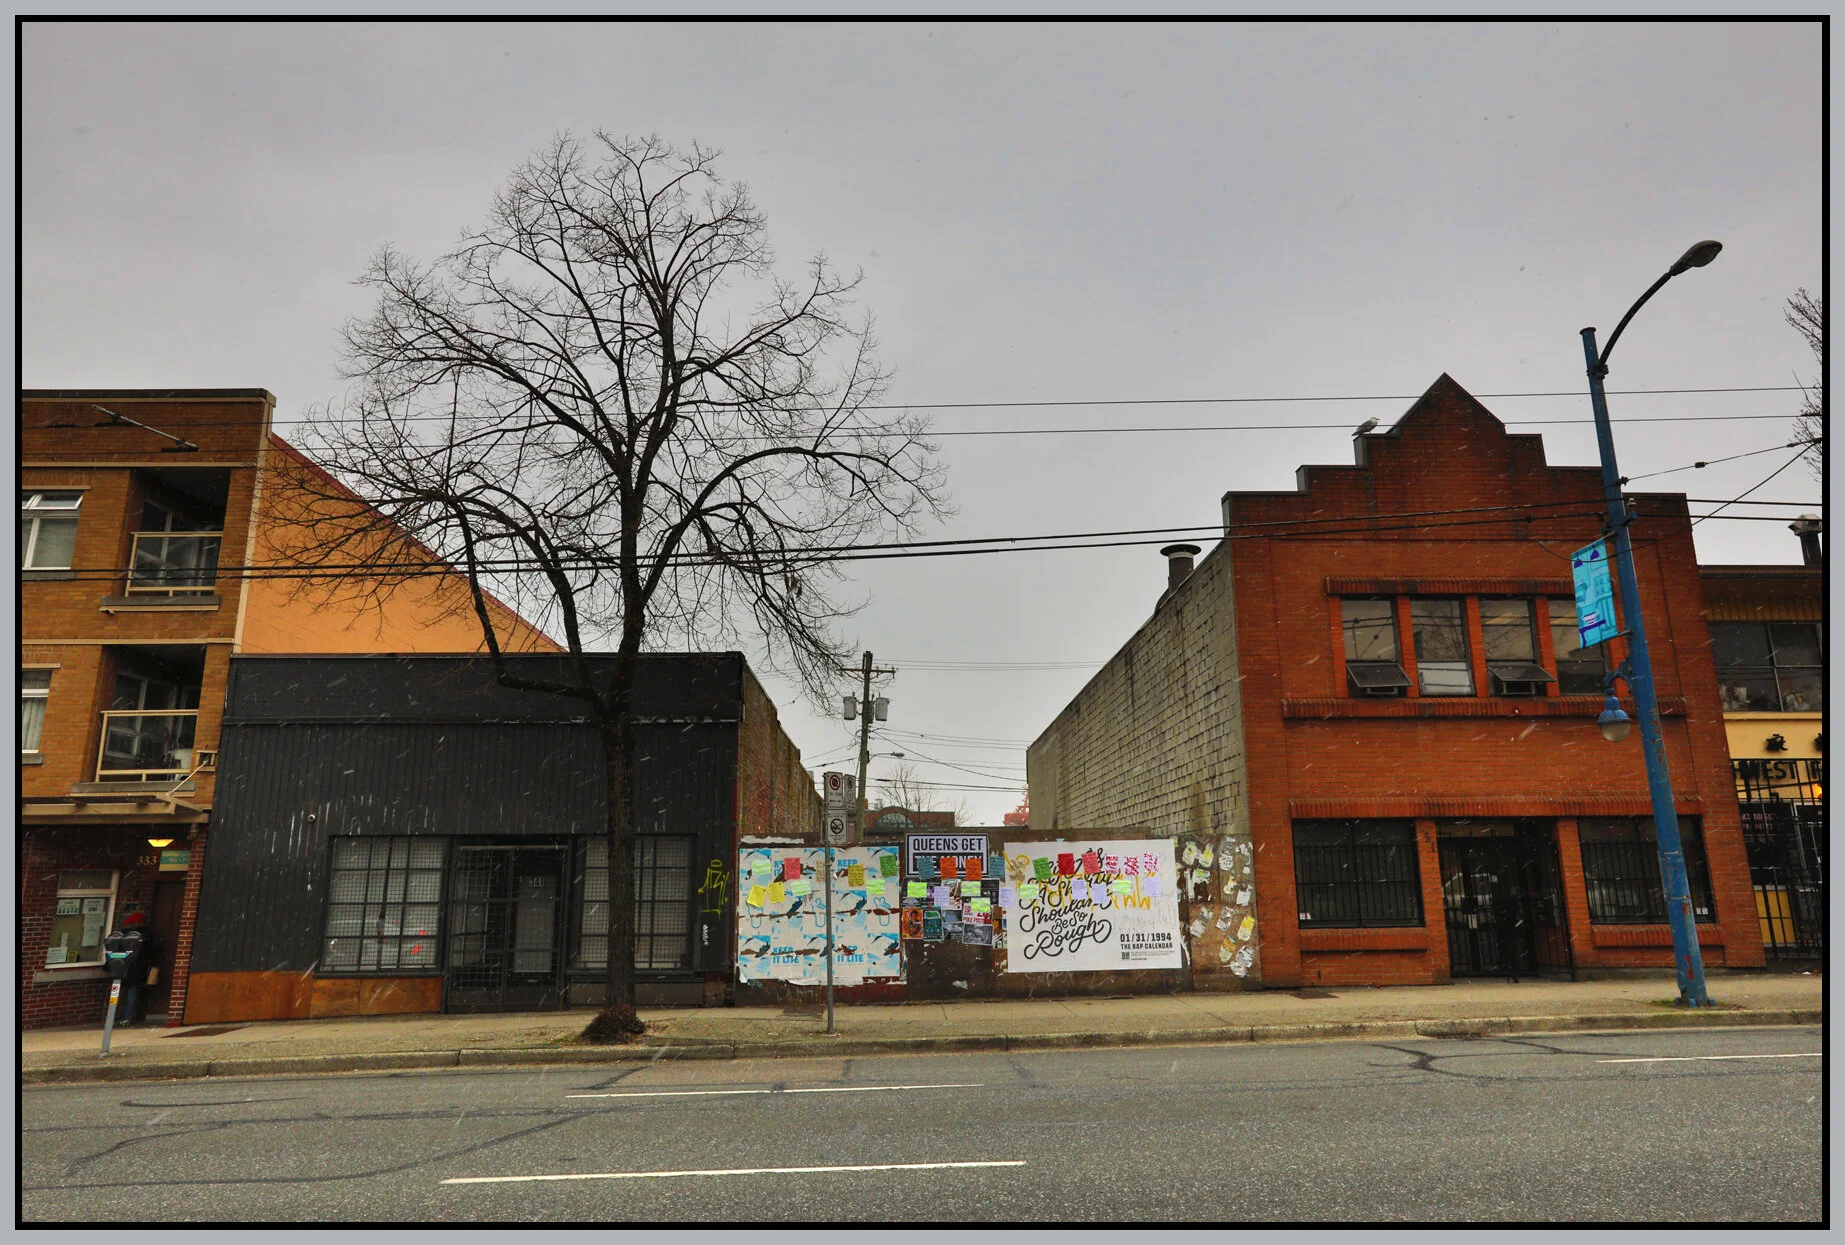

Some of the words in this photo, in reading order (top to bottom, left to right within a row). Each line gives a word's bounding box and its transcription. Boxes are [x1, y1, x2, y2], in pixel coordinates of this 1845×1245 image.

[912, 838, 958, 851] QUEENS
[961, 838, 983, 851] GET
[136, 855, 157, 865] 333
[837, 859, 858, 867] KEEP
[1052, 918, 1069, 935] Be
[1069, 910, 1088, 927] So
[1024, 912, 1112, 960] Rough
[1120, 933, 1172, 943] 01/31/1994
[773, 955, 780, 964] IT
[838, 954, 845, 963] IT
[846, 954, 863, 963] LITE
